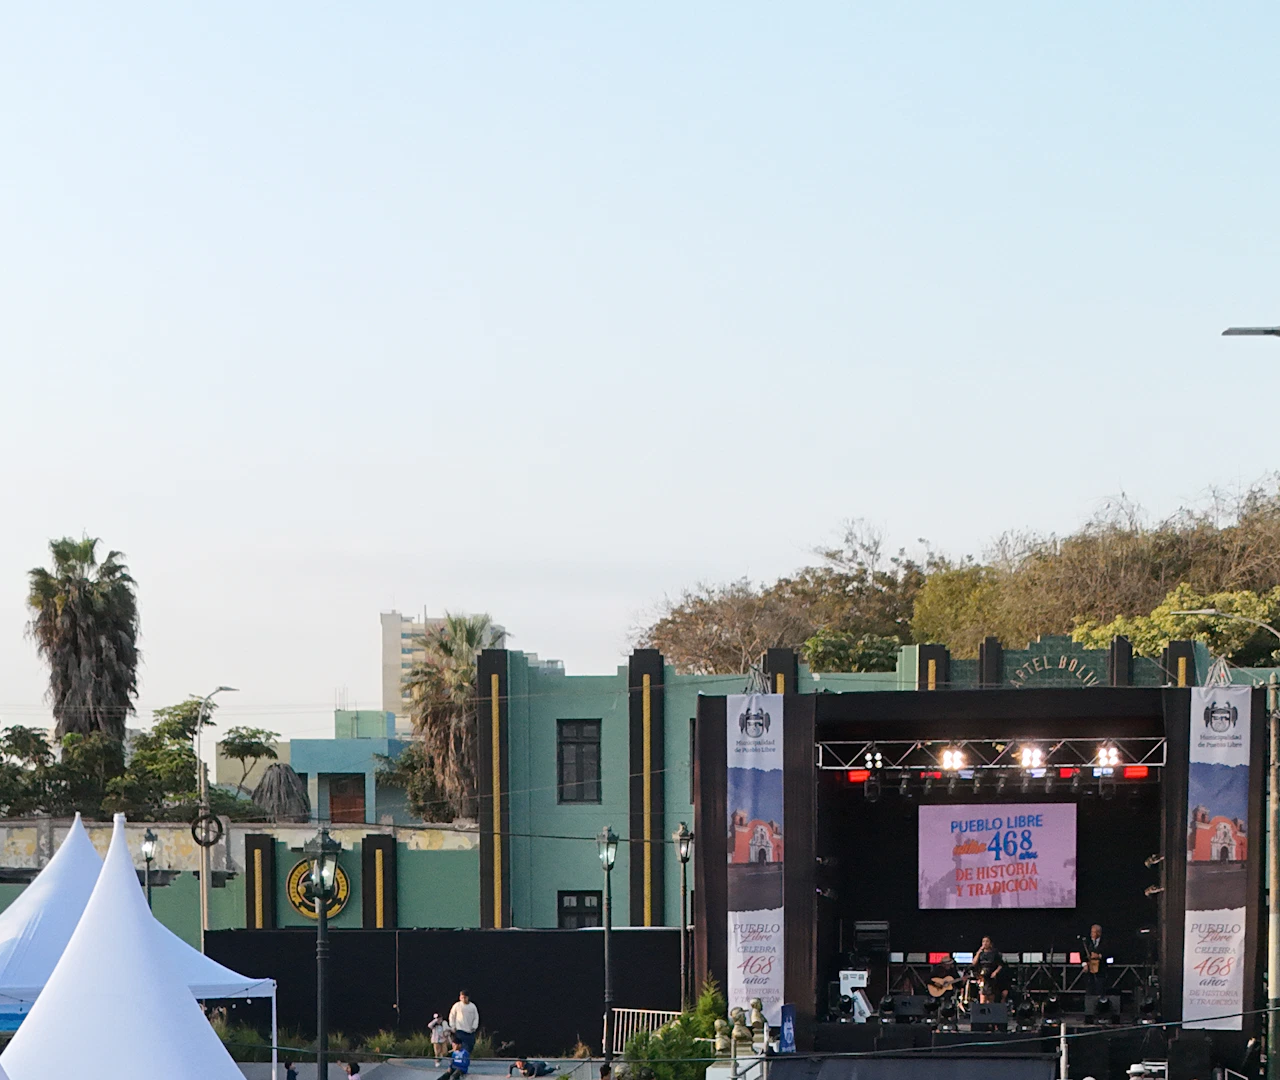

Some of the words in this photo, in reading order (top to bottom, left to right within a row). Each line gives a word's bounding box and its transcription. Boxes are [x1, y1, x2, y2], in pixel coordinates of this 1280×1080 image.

[1010, 656, 1052, 689] ARTEL
[950, 818, 1003, 833] PUEBLO
[1007, 814, 1043, 828] LIBRE
[988, 830, 1032, 861] 468
[955, 868, 973, 882] DE
[976, 862, 1038, 880] HISTORIA
[956, 885, 964, 897] Y
[968, 876, 1038, 896] TRADICIÓN
[733, 924, 780, 933] PUEBLO
[740, 929, 772, 944] Libre
[1191, 924, 1241, 934] PUEBLO
[1197, 929, 1233, 944] Libre
[737, 956, 775, 974] 468
[1194, 956, 1235, 976] 468
[742, 976, 770, 985] años
[1199, 977, 1228, 986] años
